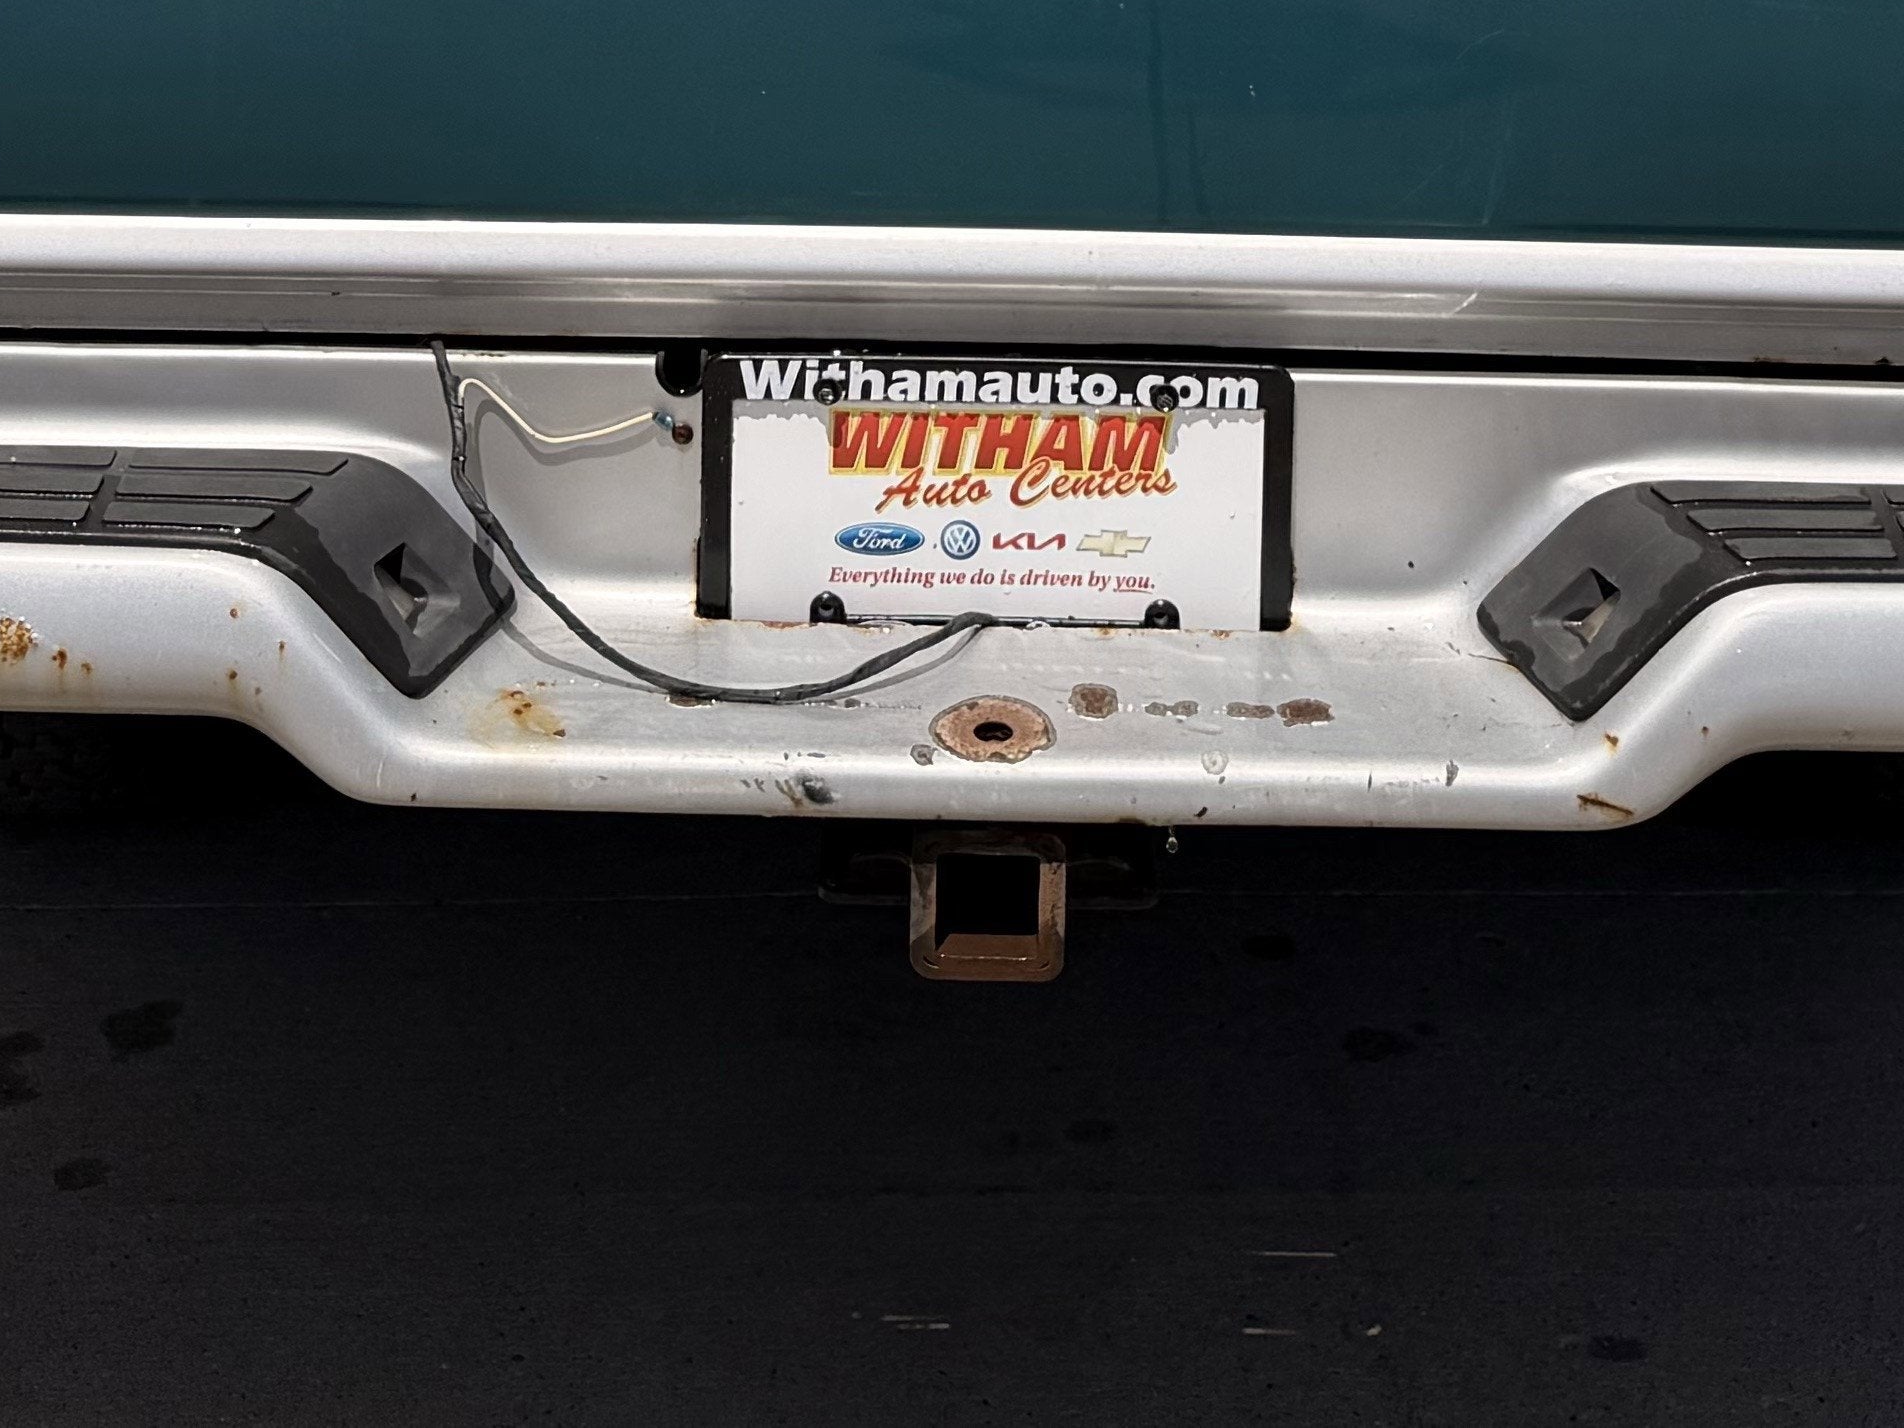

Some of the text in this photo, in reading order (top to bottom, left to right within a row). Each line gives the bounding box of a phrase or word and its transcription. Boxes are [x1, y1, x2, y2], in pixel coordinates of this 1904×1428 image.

[739, 359, 1259, 410] Withamauto.com
[831, 408, 1172, 474] WITHAM
[875, 456, 1179, 515] Auto Centers
[828, 566, 1155, 594] Everything we do is driven by you.
